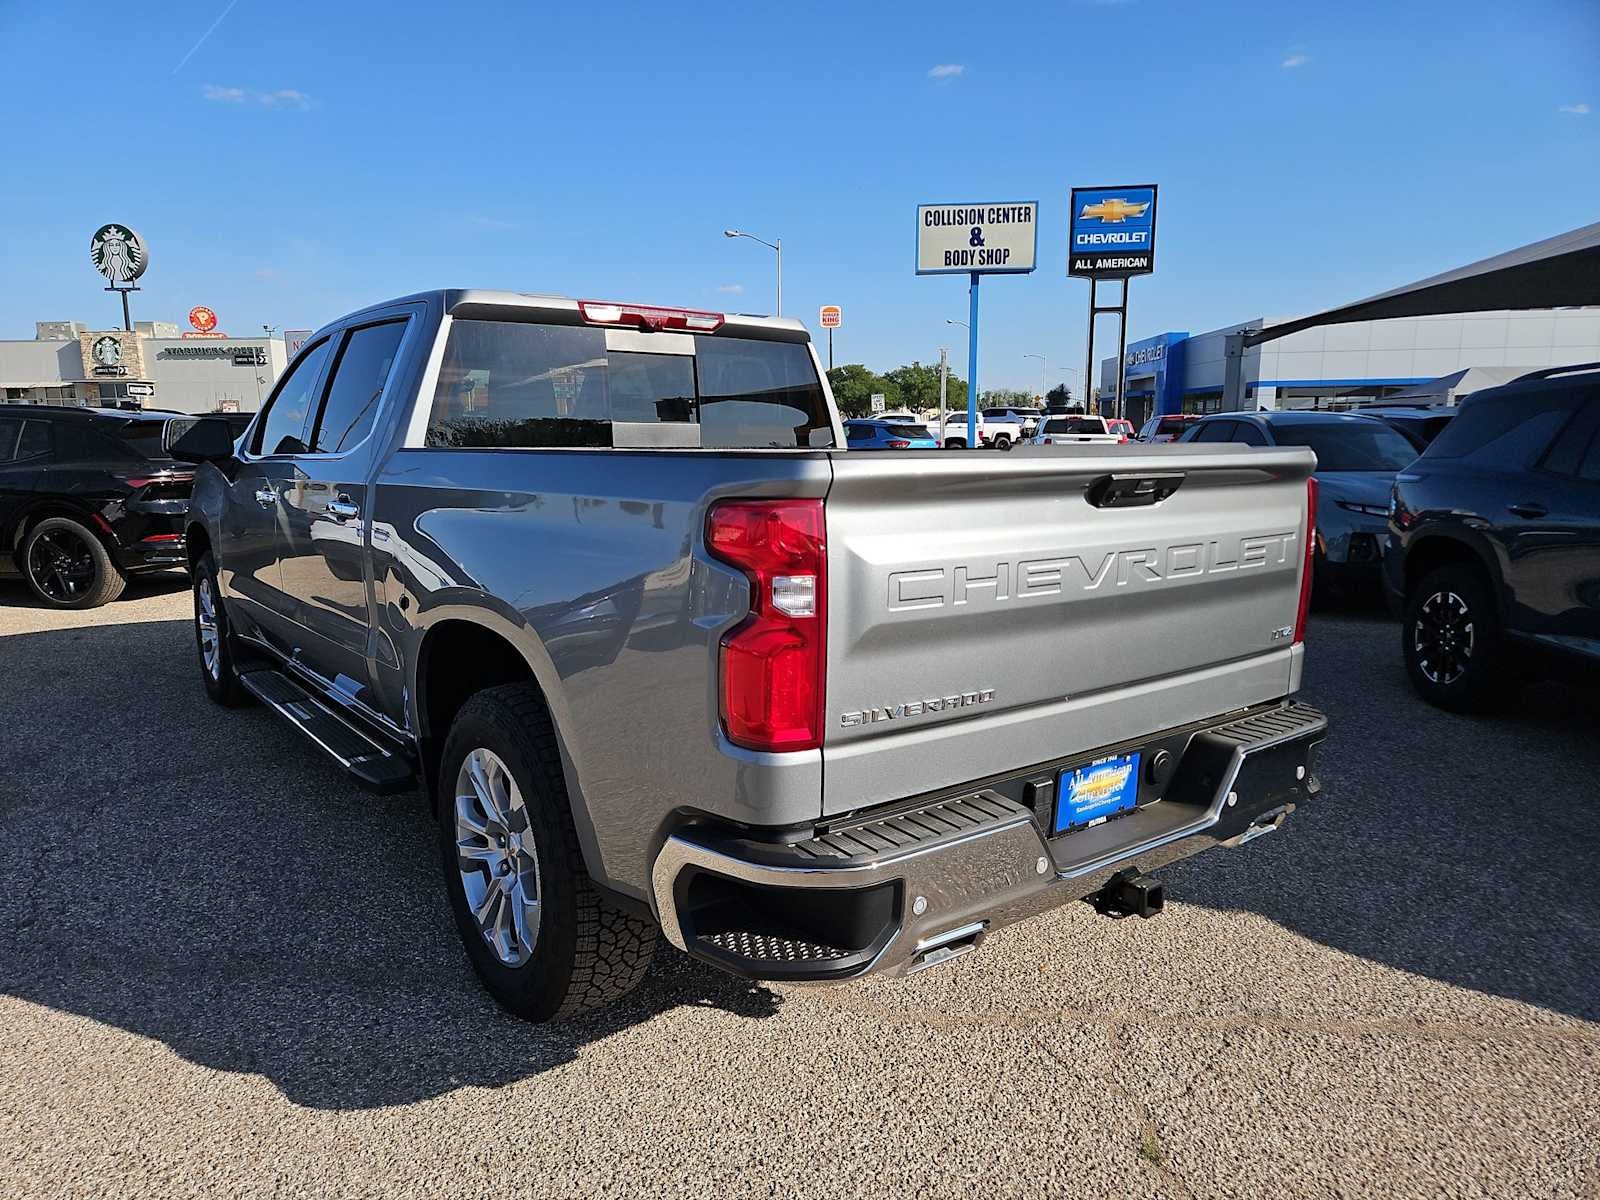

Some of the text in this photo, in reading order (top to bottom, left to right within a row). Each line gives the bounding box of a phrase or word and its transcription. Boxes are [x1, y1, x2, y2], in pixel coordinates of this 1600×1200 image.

[925, 206, 1031, 226] COLLISION CENTER
[969, 227, 985, 247] &
[1077, 232, 1147, 244] CHEVROLET
[944, 248, 1010, 266] BODY SHOP
[1075, 257, 1148, 270] ALL AMERICAN
[1135, 345, 1164, 364] CHEVROLET
[887, 532, 1297, 612] CHEVROLET
[841, 688, 996, 728] SILVERADO
